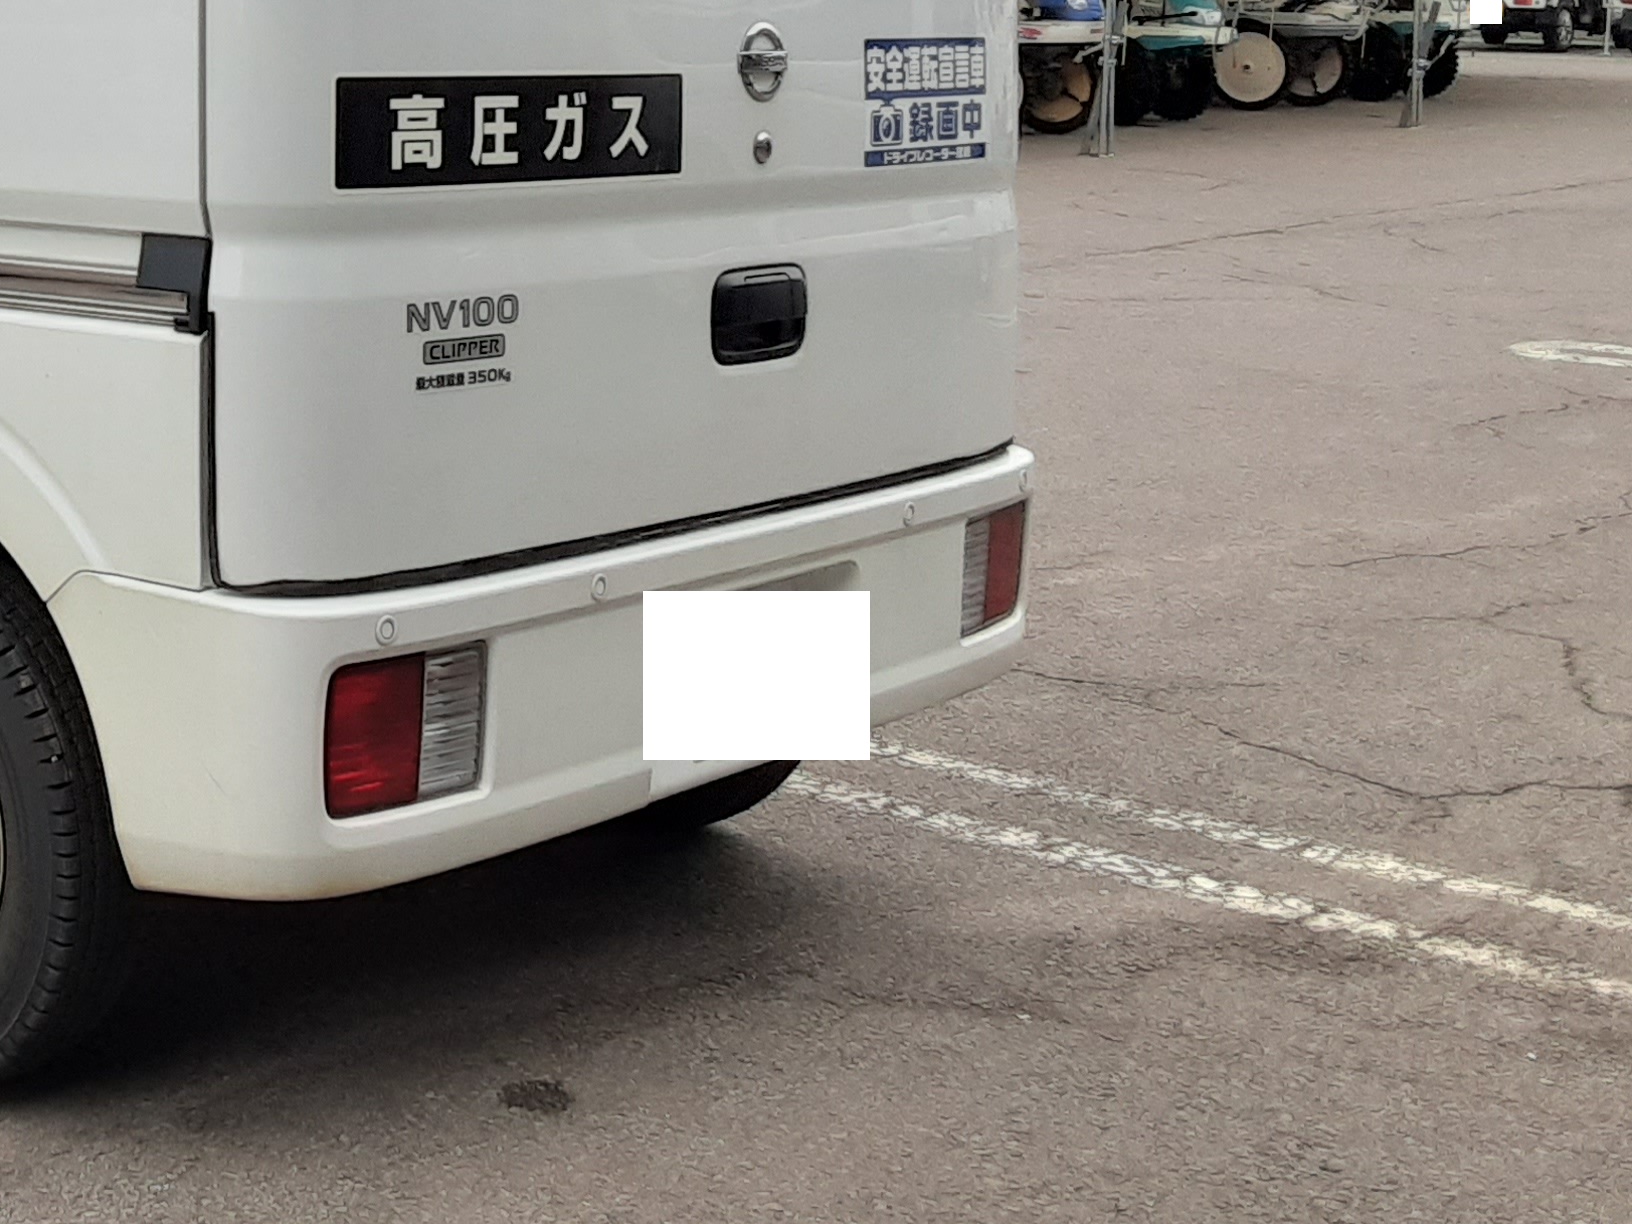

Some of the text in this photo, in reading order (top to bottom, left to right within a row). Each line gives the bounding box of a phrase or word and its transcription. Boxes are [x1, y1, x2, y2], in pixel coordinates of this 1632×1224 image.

[866, 44, 985, 93] 安全運転宣言車
[388, 90, 649, 171] 高圧ガス
[908, 98, 982, 143] 録画中
[406, 294, 519, 333] NV100
[429, 338, 500, 360] CLIPPER
